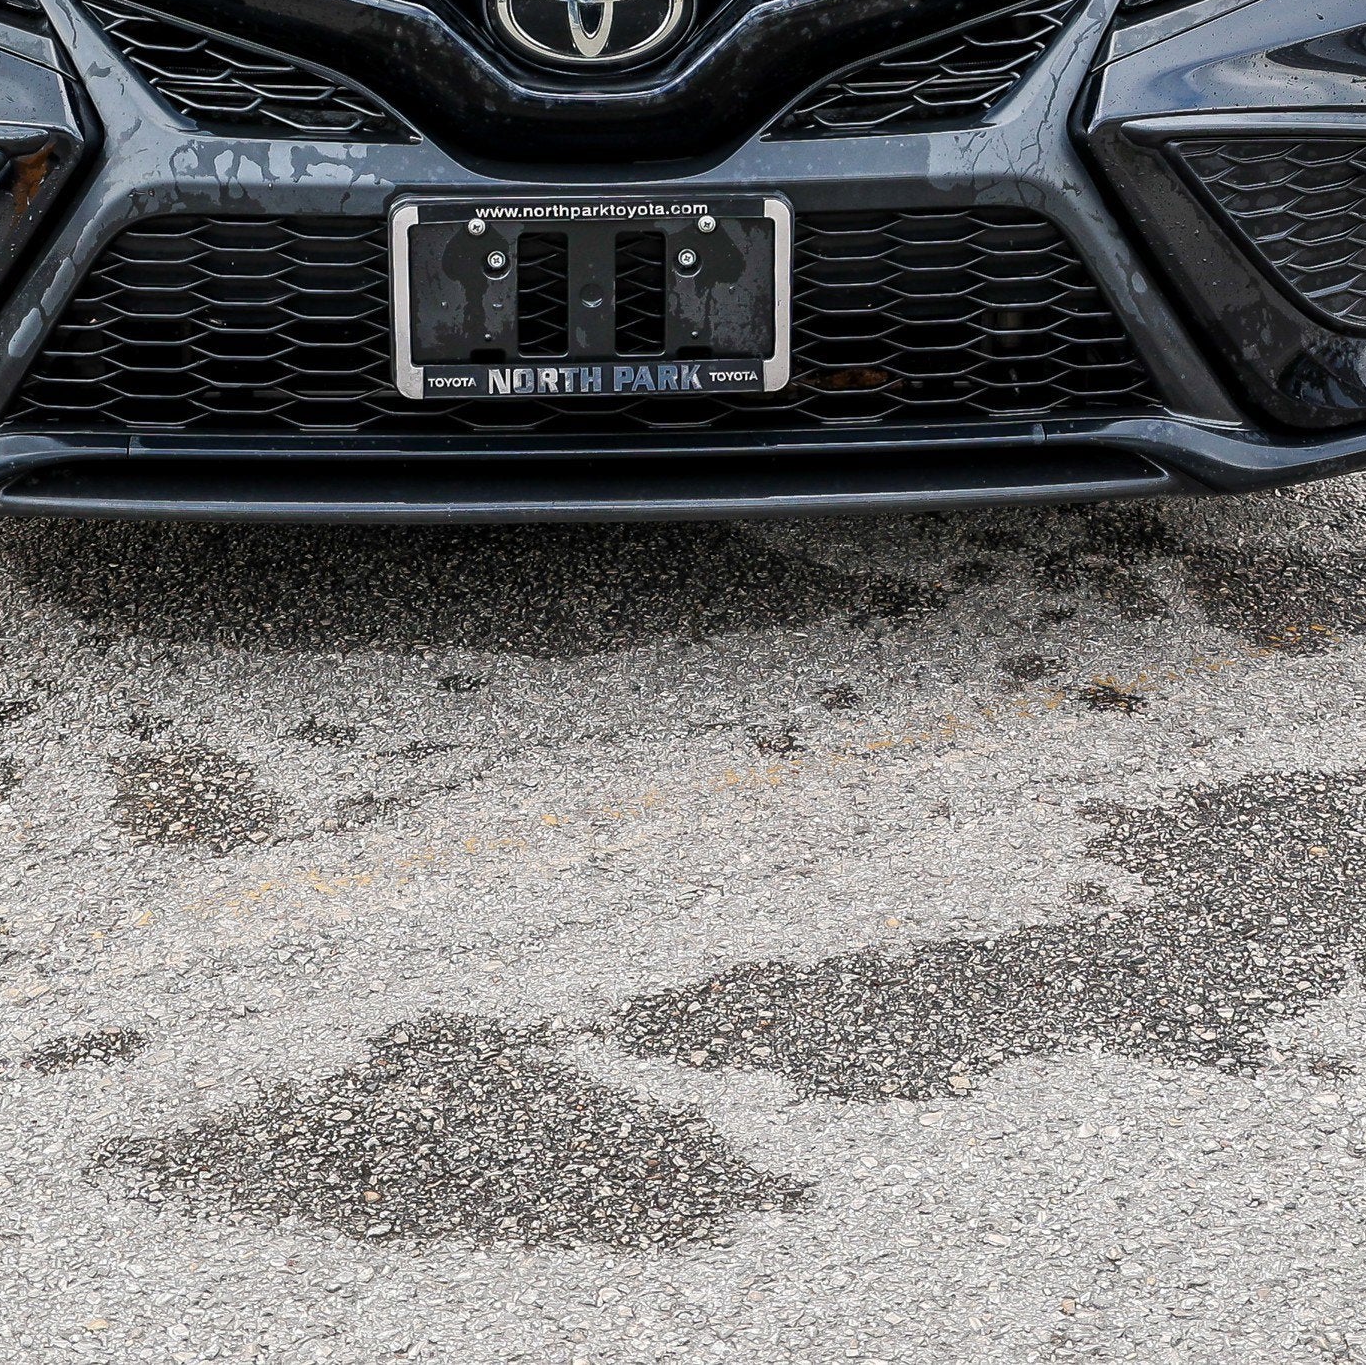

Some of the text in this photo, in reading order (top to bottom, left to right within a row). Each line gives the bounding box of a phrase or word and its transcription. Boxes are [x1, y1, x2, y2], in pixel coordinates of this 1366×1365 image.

[475, 203, 708, 220] www.northparktoyota.com
[428, 364, 758, 394] TOYOTA NORTH PARK TOYOTA
